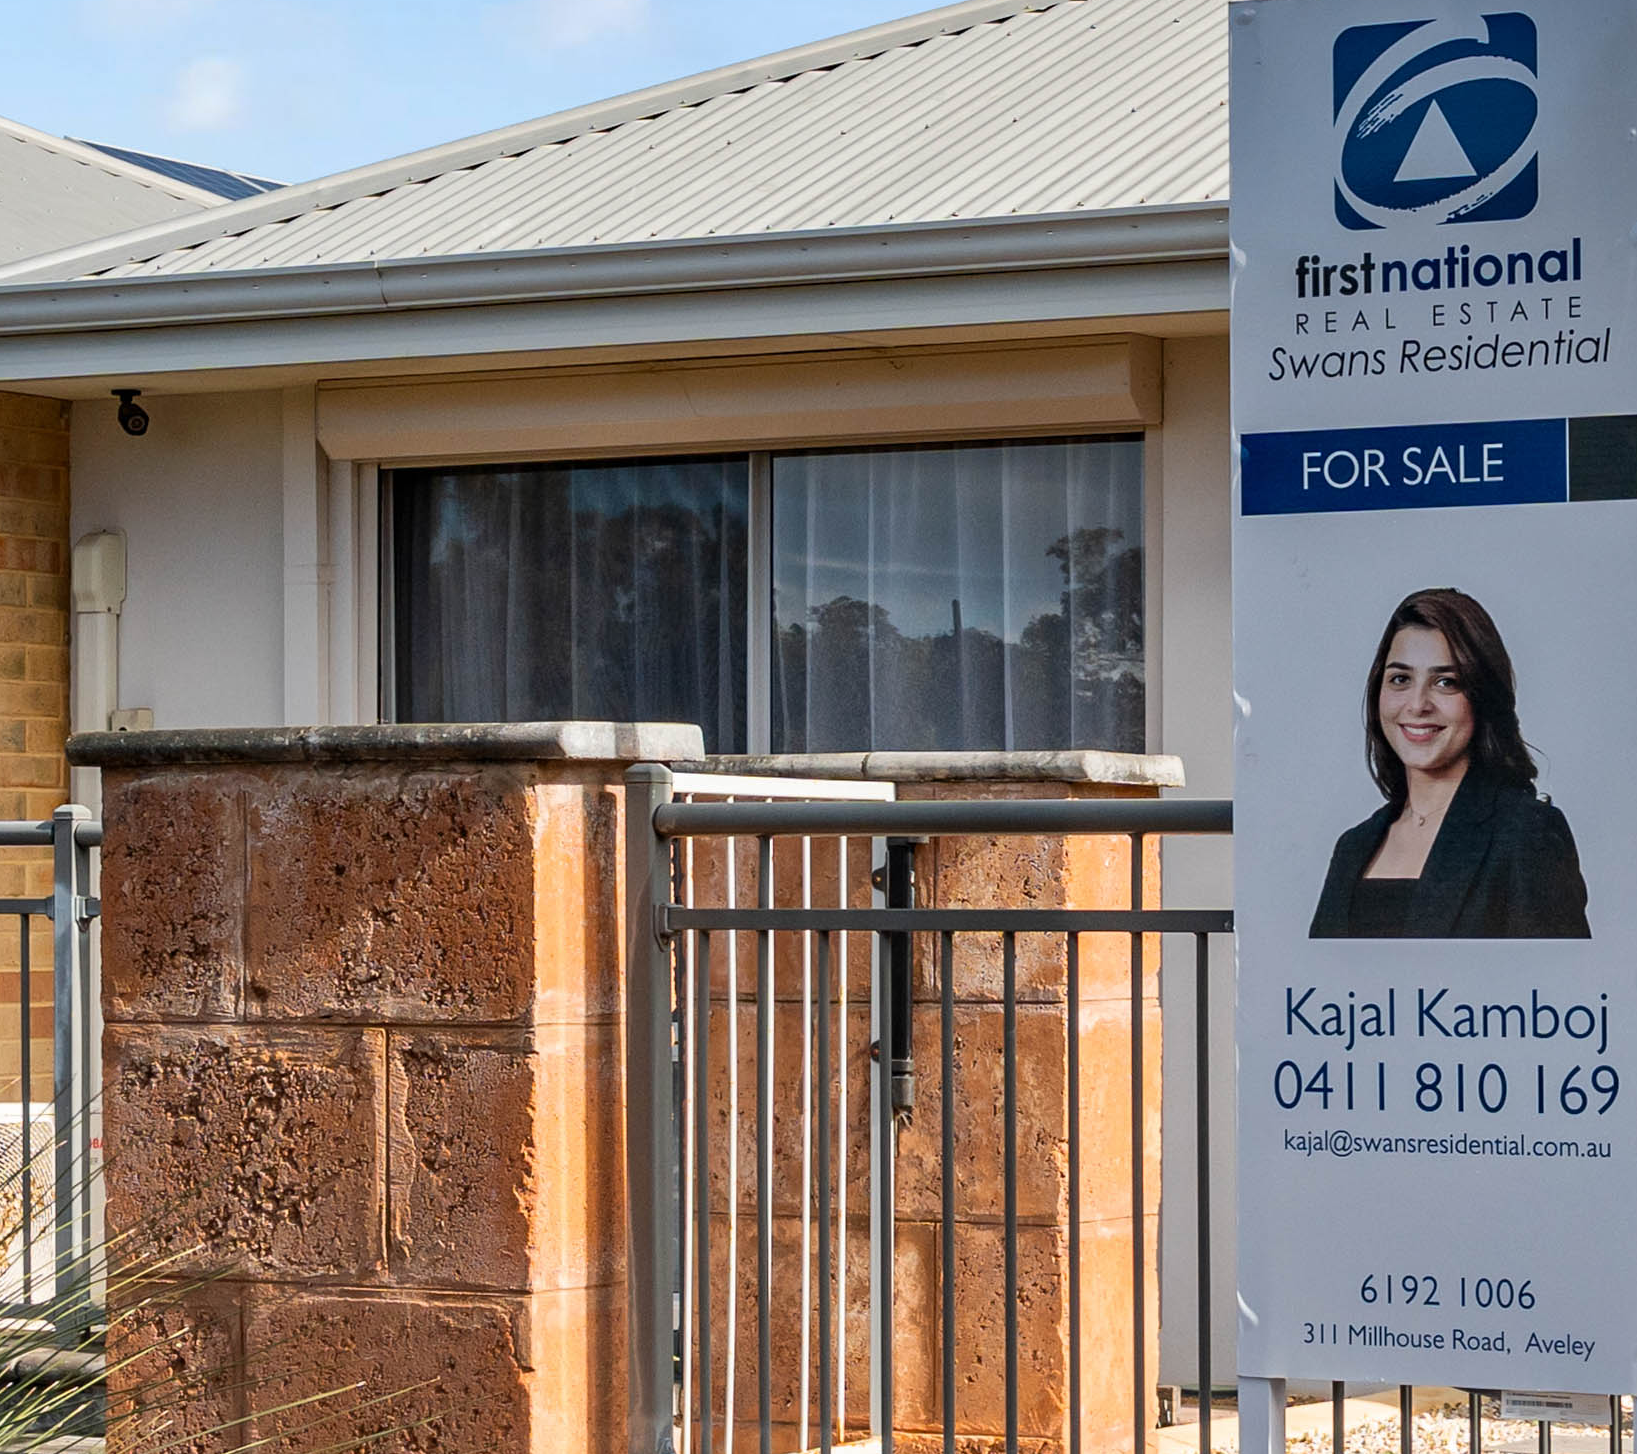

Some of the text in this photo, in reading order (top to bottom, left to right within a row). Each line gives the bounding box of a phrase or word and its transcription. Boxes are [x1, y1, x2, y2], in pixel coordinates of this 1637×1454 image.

[1296, 296, 1582, 335] REAL ESTATE
[1268, 328, 1611, 381] Swans Residential
[1302, 442, 1505, 491] FOR SALE
[1286, 987, 1609, 1056] Kajal Kamboj
[1273, 1059, 1621, 1117] 0411 810 169
[1283, 1128, 1612, 1159] kajal@swansresidential.com.au
[1360, 1273, 1537, 1311] 6192 1006
[1303, 1322, 1597, 1363] 311 Millhouse Road, Aveley
